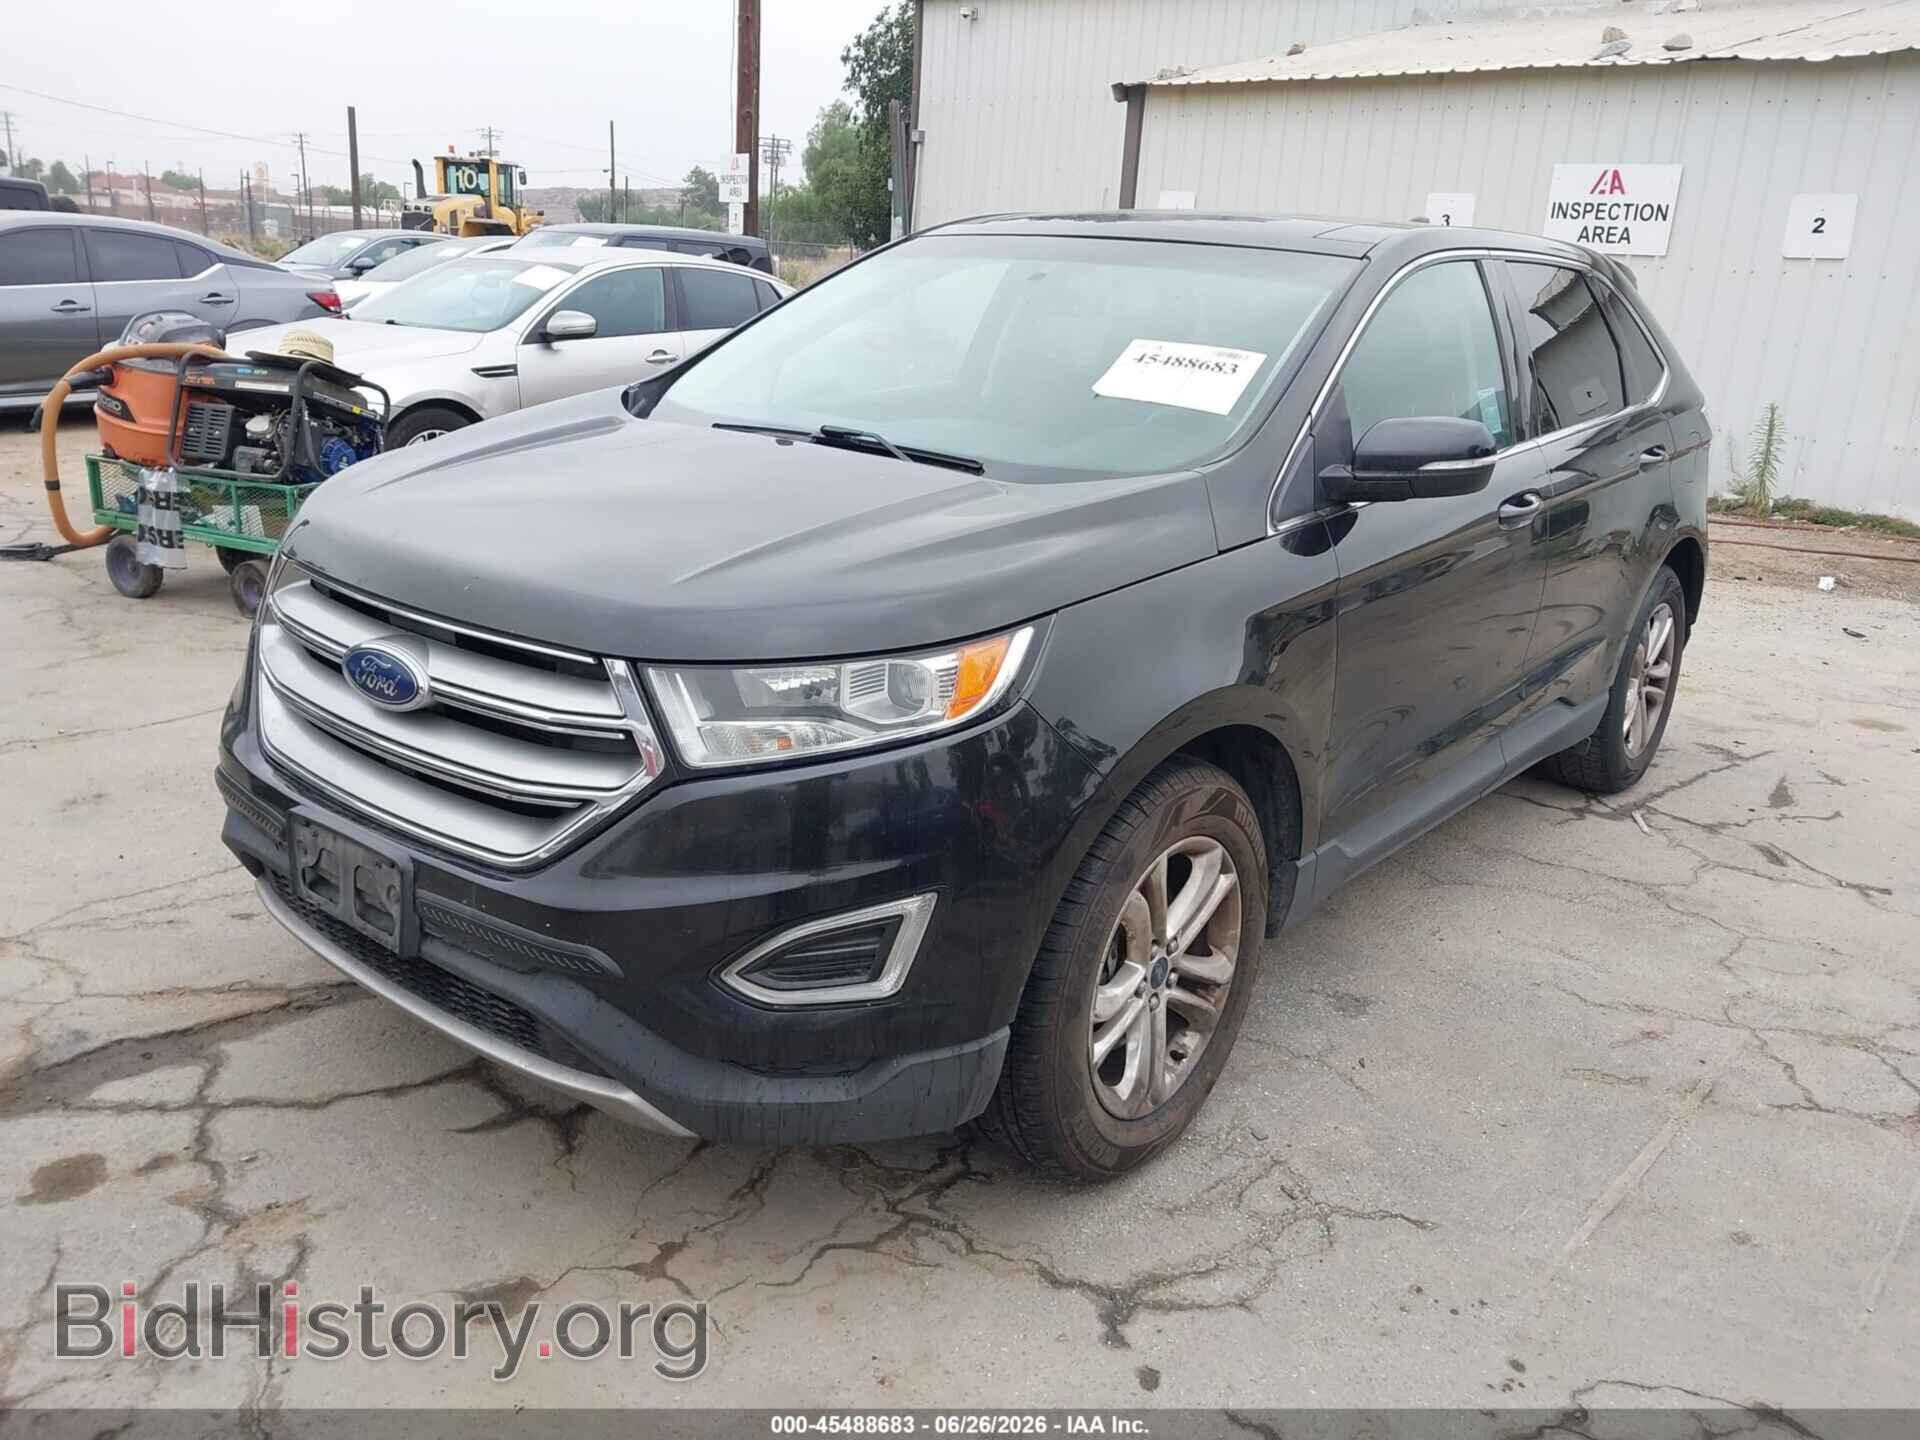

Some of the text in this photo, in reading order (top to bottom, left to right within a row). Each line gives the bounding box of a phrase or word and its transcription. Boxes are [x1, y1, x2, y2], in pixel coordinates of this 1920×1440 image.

[456, 169, 477, 191] 10
[1550, 201, 1669, 221] INSPECTION
[1577, 226, 1632, 244] AREA
[1811, 217, 1826, 234] 2
[1132, 352, 1240, 375] 45488683
[355, 655, 401, 697] Ford
